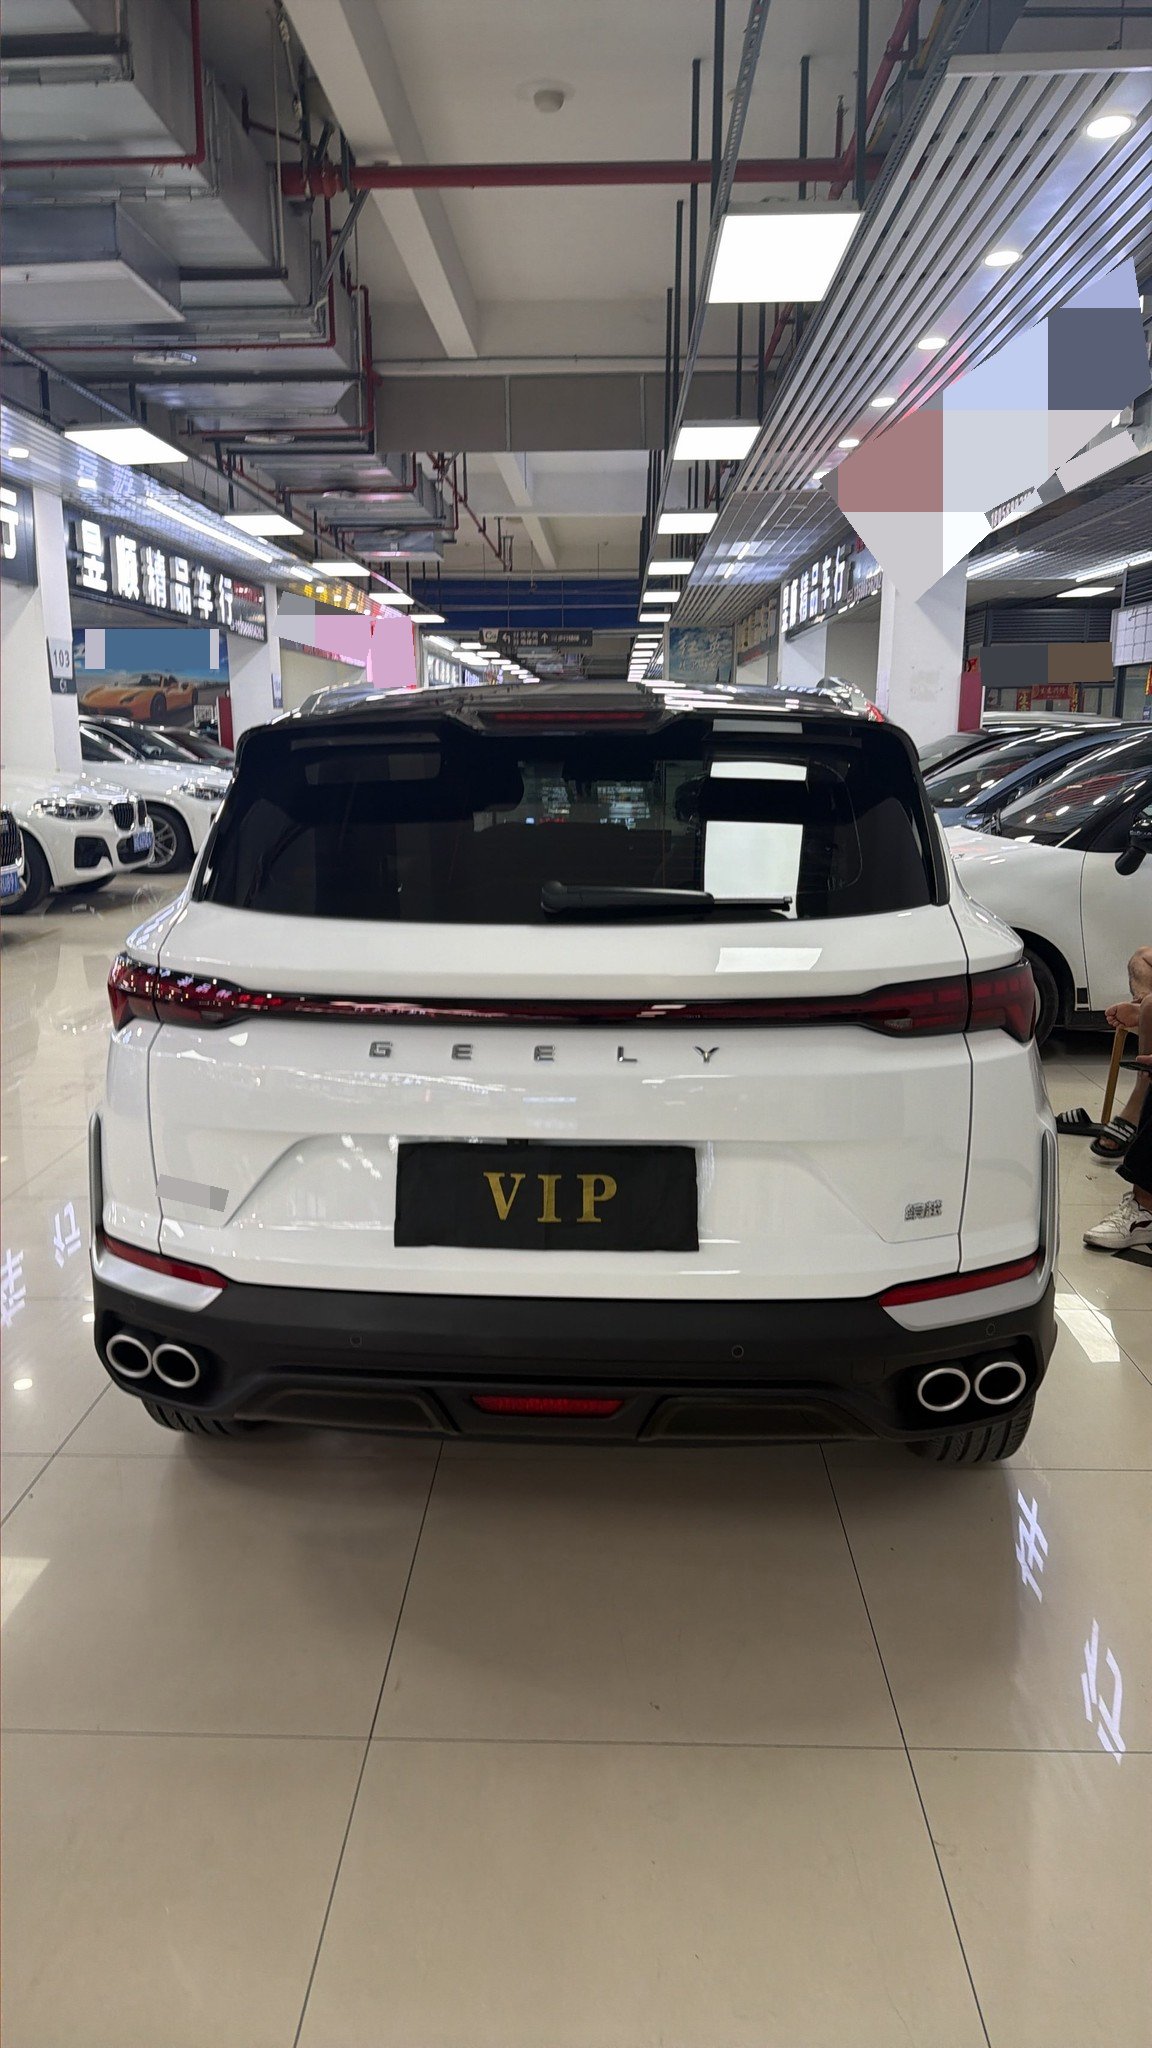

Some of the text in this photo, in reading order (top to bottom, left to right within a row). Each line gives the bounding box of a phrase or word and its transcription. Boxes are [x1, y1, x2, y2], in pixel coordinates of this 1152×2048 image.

[53, 649, 70, 668] 103
[369, 1041, 719, 1063] GEELY
[483, 1171, 617, 1223] VIP
